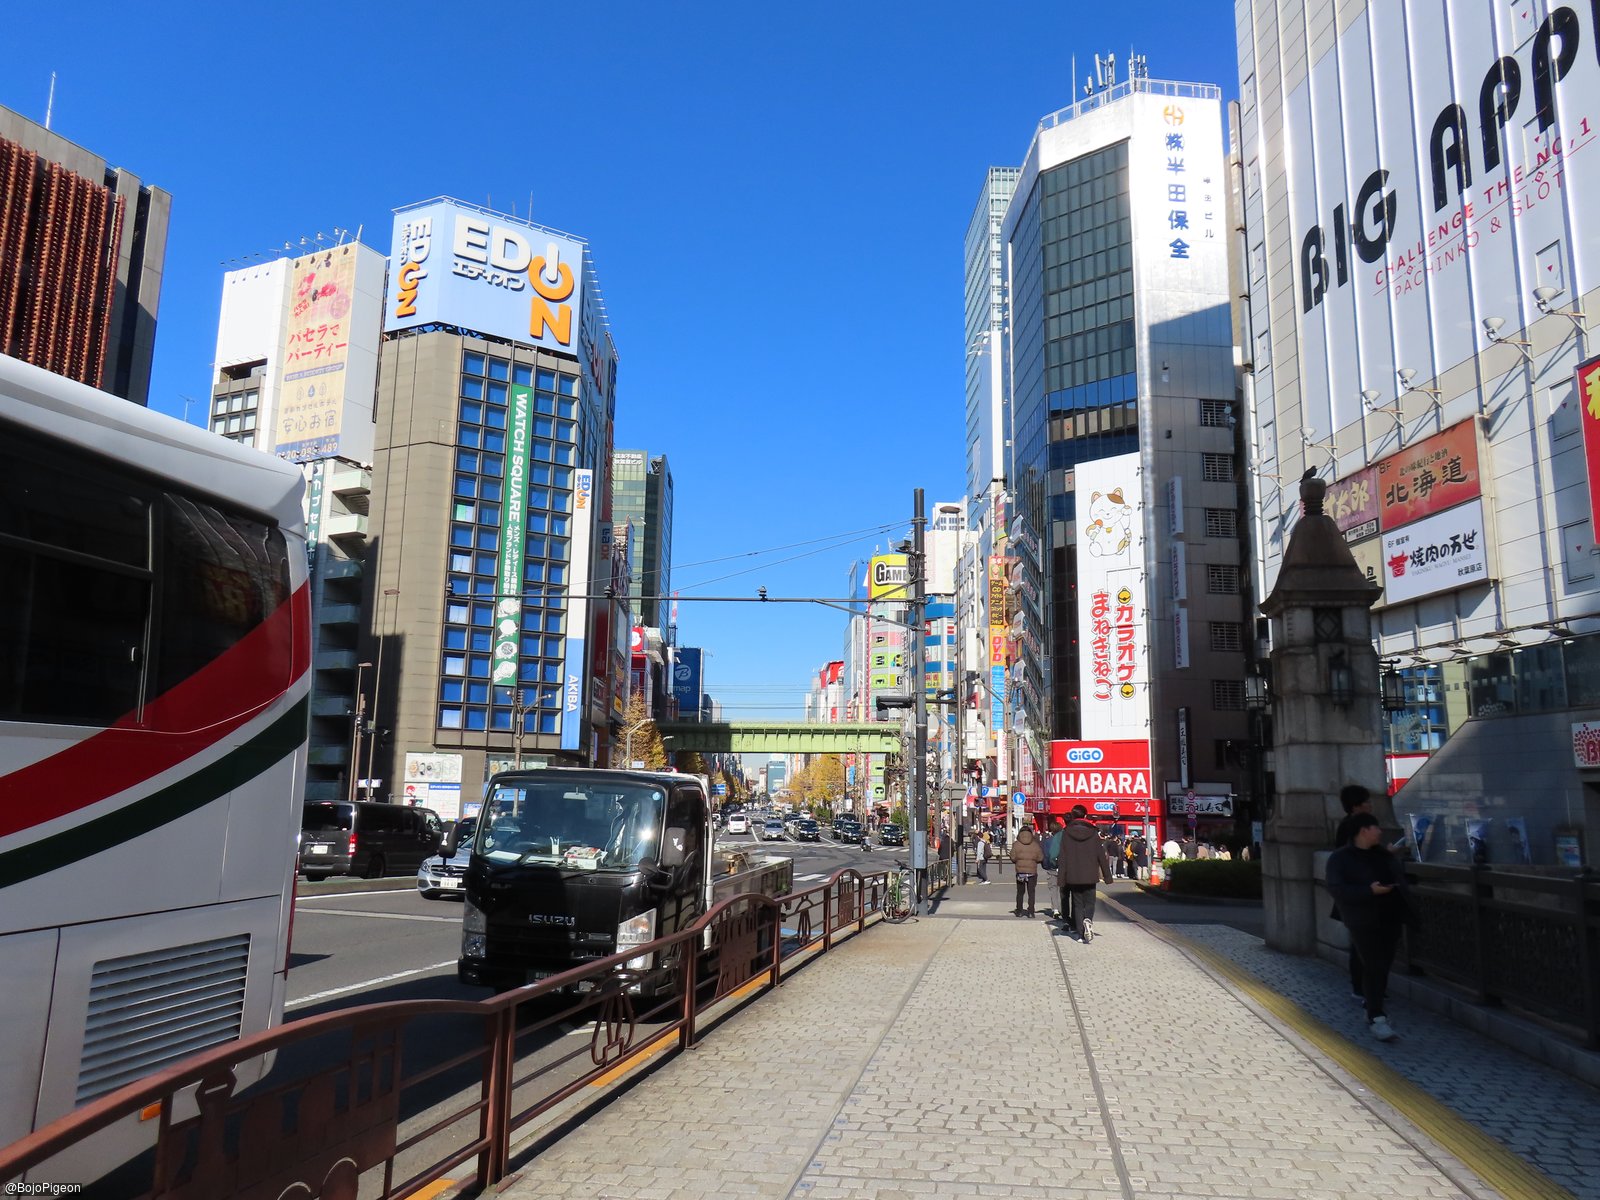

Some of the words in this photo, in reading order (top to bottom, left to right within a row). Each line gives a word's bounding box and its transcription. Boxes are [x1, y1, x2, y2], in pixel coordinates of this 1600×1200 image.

[1301, 168, 1397, 314] BIG
[1430, 0, 1600, 213] APP
[1375, 202, 1475, 285] CHALLENGE
[1483, 164, 1525, 205] THE
[1393, 230, 1480, 300] PACHINKO
[1490, 216, 1503, 233] &
[1512, 169, 1565, 218] SLOT
[395, 216, 434, 318] EDION
[452, 259, 526, 291] エディオン
[453, 213, 575, 345] EDION
[286, 341, 348, 365] パーティー
[513, 393, 528, 452] WATCH
[508, 455, 524, 522] SQUARE
[576, 474, 591, 510] EDION
[1379, 461, 1392, 474] 8F
[1385, 455, 1468, 507] 北海道
[1409, 529, 1478, 568] 焼肉の万世
[1457, 562, 1483, 577] 秋葉原店
[1091, 591, 1111, 701] まねきねこ
[1116, 605, 1136, 682] カラオケ
[567, 674, 579, 713] AKIBA
[1068, 749, 1101, 761] GiGO
[529, 914, 575, 927] ISUZU
